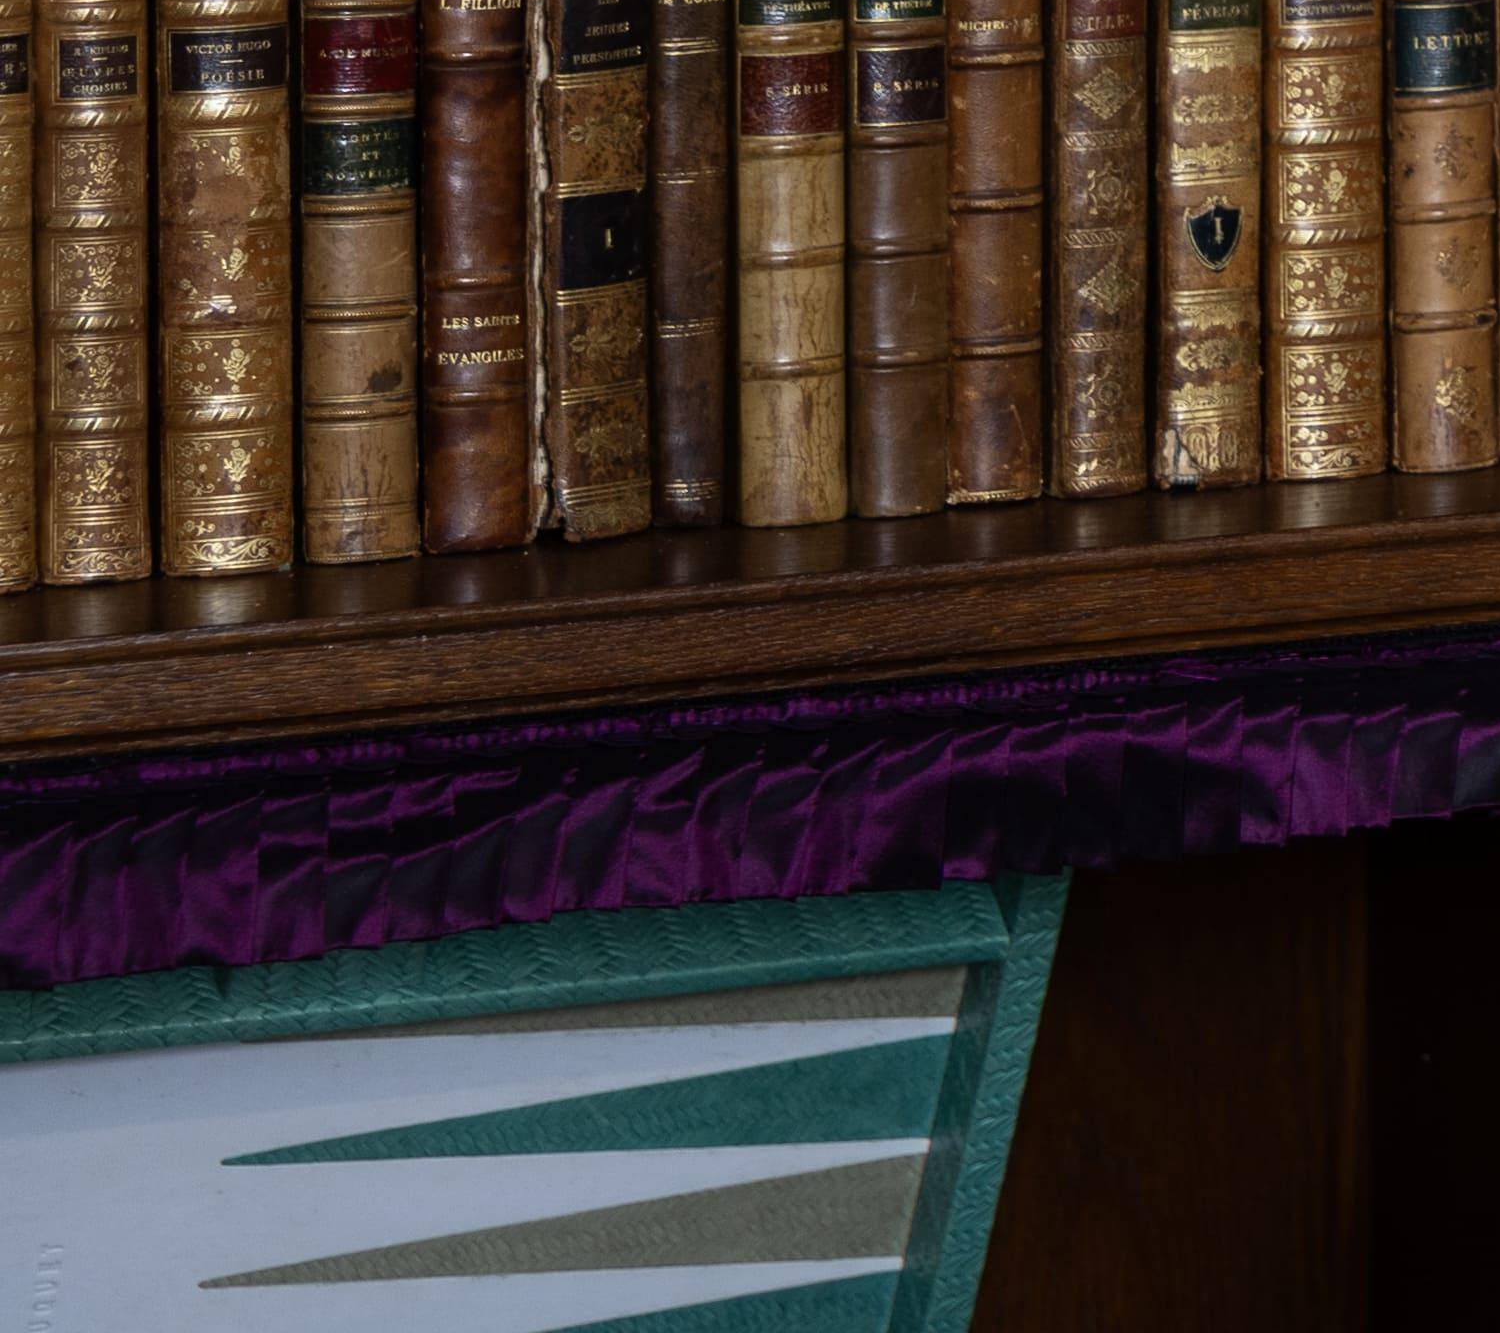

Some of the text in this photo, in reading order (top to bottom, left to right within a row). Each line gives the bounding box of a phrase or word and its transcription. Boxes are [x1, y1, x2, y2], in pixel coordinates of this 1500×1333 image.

[185, 39, 273, 56] VICTOR HUGO
[199, 68, 266, 85] POÉSIE
[72, 80, 128, 95] CHOISIES
[442, 314, 521, 331] LES SAINTS
[437, 346, 526, 367] ÉVANGILES
